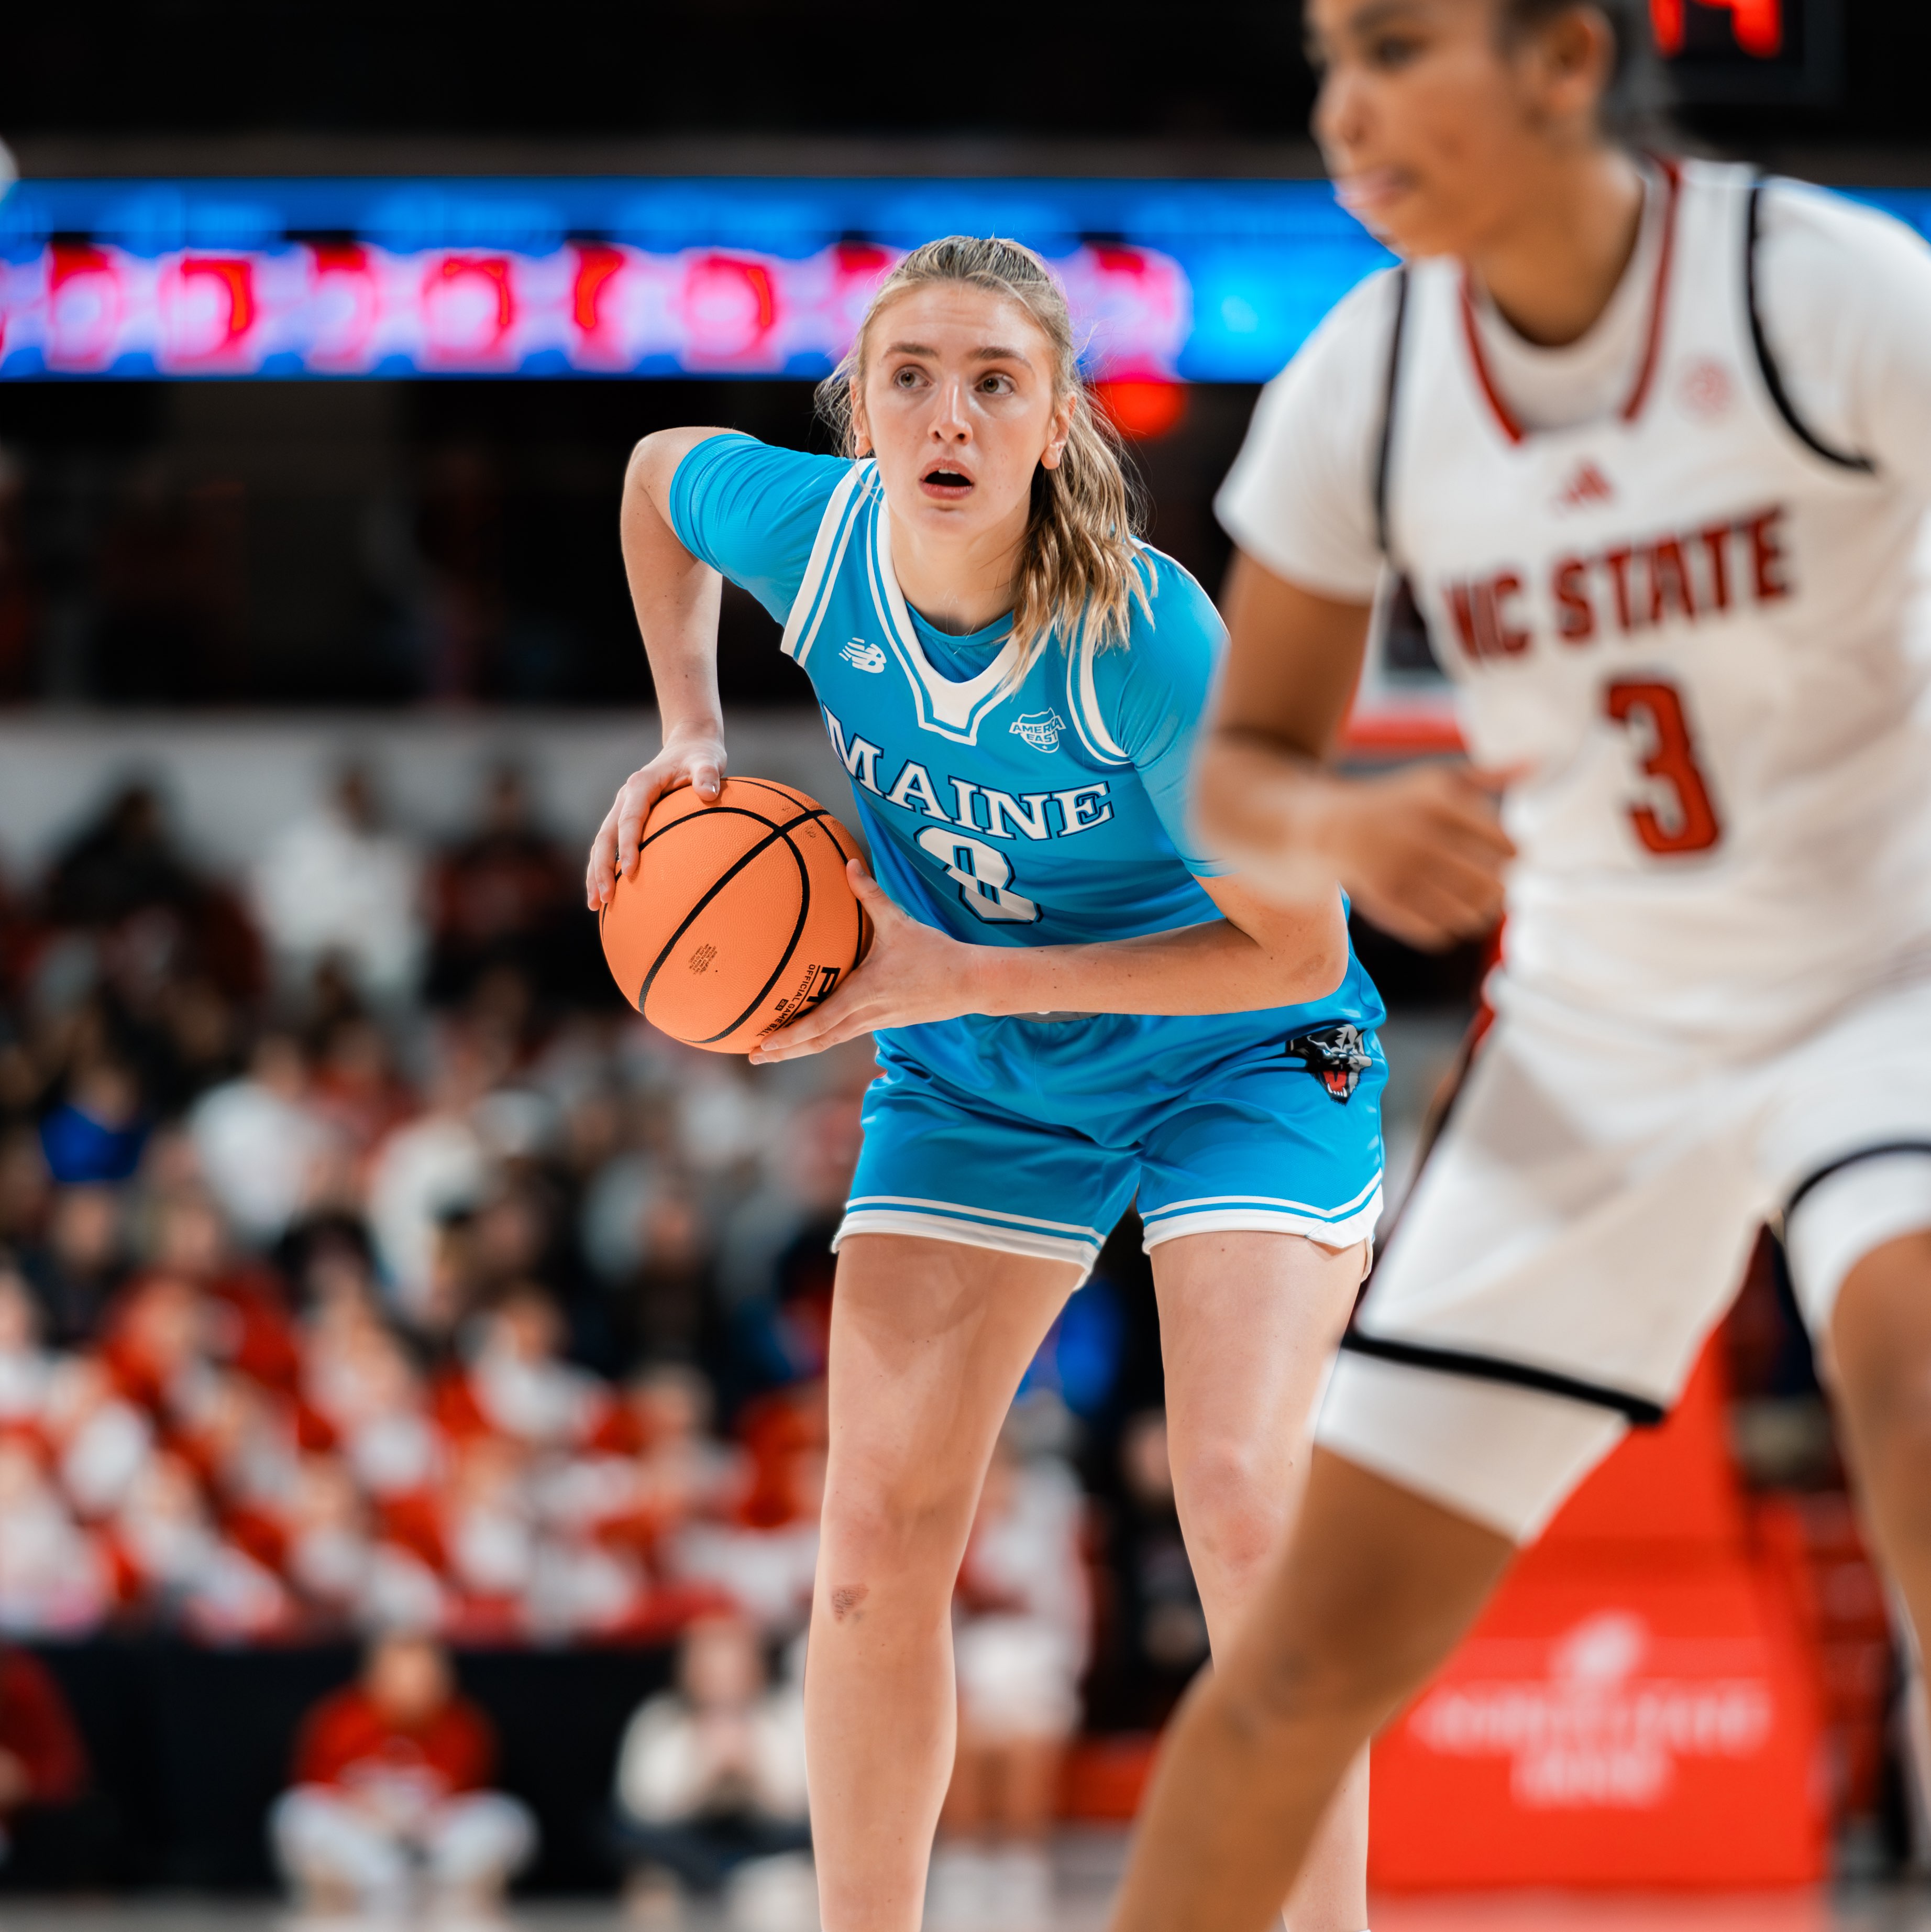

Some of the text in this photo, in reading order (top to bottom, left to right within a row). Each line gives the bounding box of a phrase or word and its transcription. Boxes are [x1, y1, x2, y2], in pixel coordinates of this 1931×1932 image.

[1551, 503, 1791, 646] STATE
[822, 700, 1115, 841] MAINE
[1604, 677, 1723, 856] 3
[756, 964, 815, 1037] OFFICIAL GAME BALL
